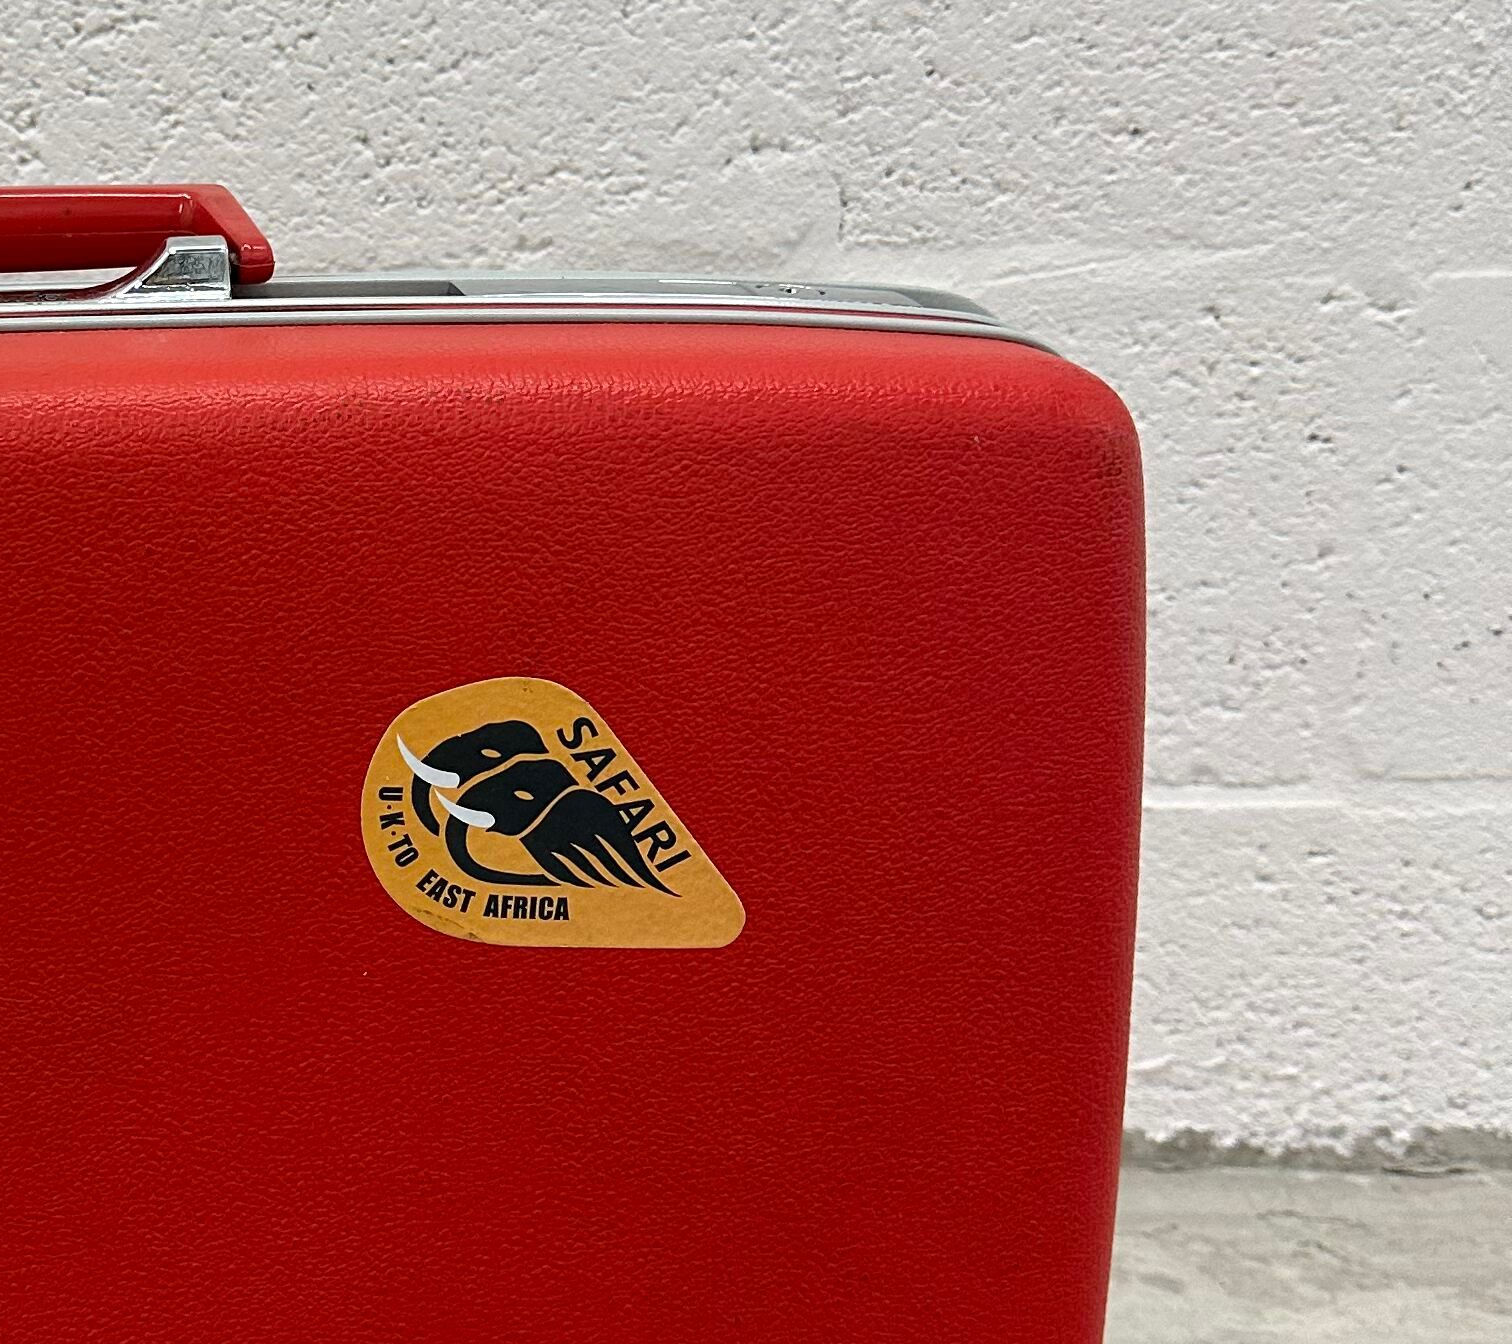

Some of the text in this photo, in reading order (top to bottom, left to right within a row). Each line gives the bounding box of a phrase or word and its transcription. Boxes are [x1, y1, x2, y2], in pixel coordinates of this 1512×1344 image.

[557, 717, 692, 872] SAFARI
[415, 868, 476, 913] EAST
[482, 894, 569, 921] AFRICA
